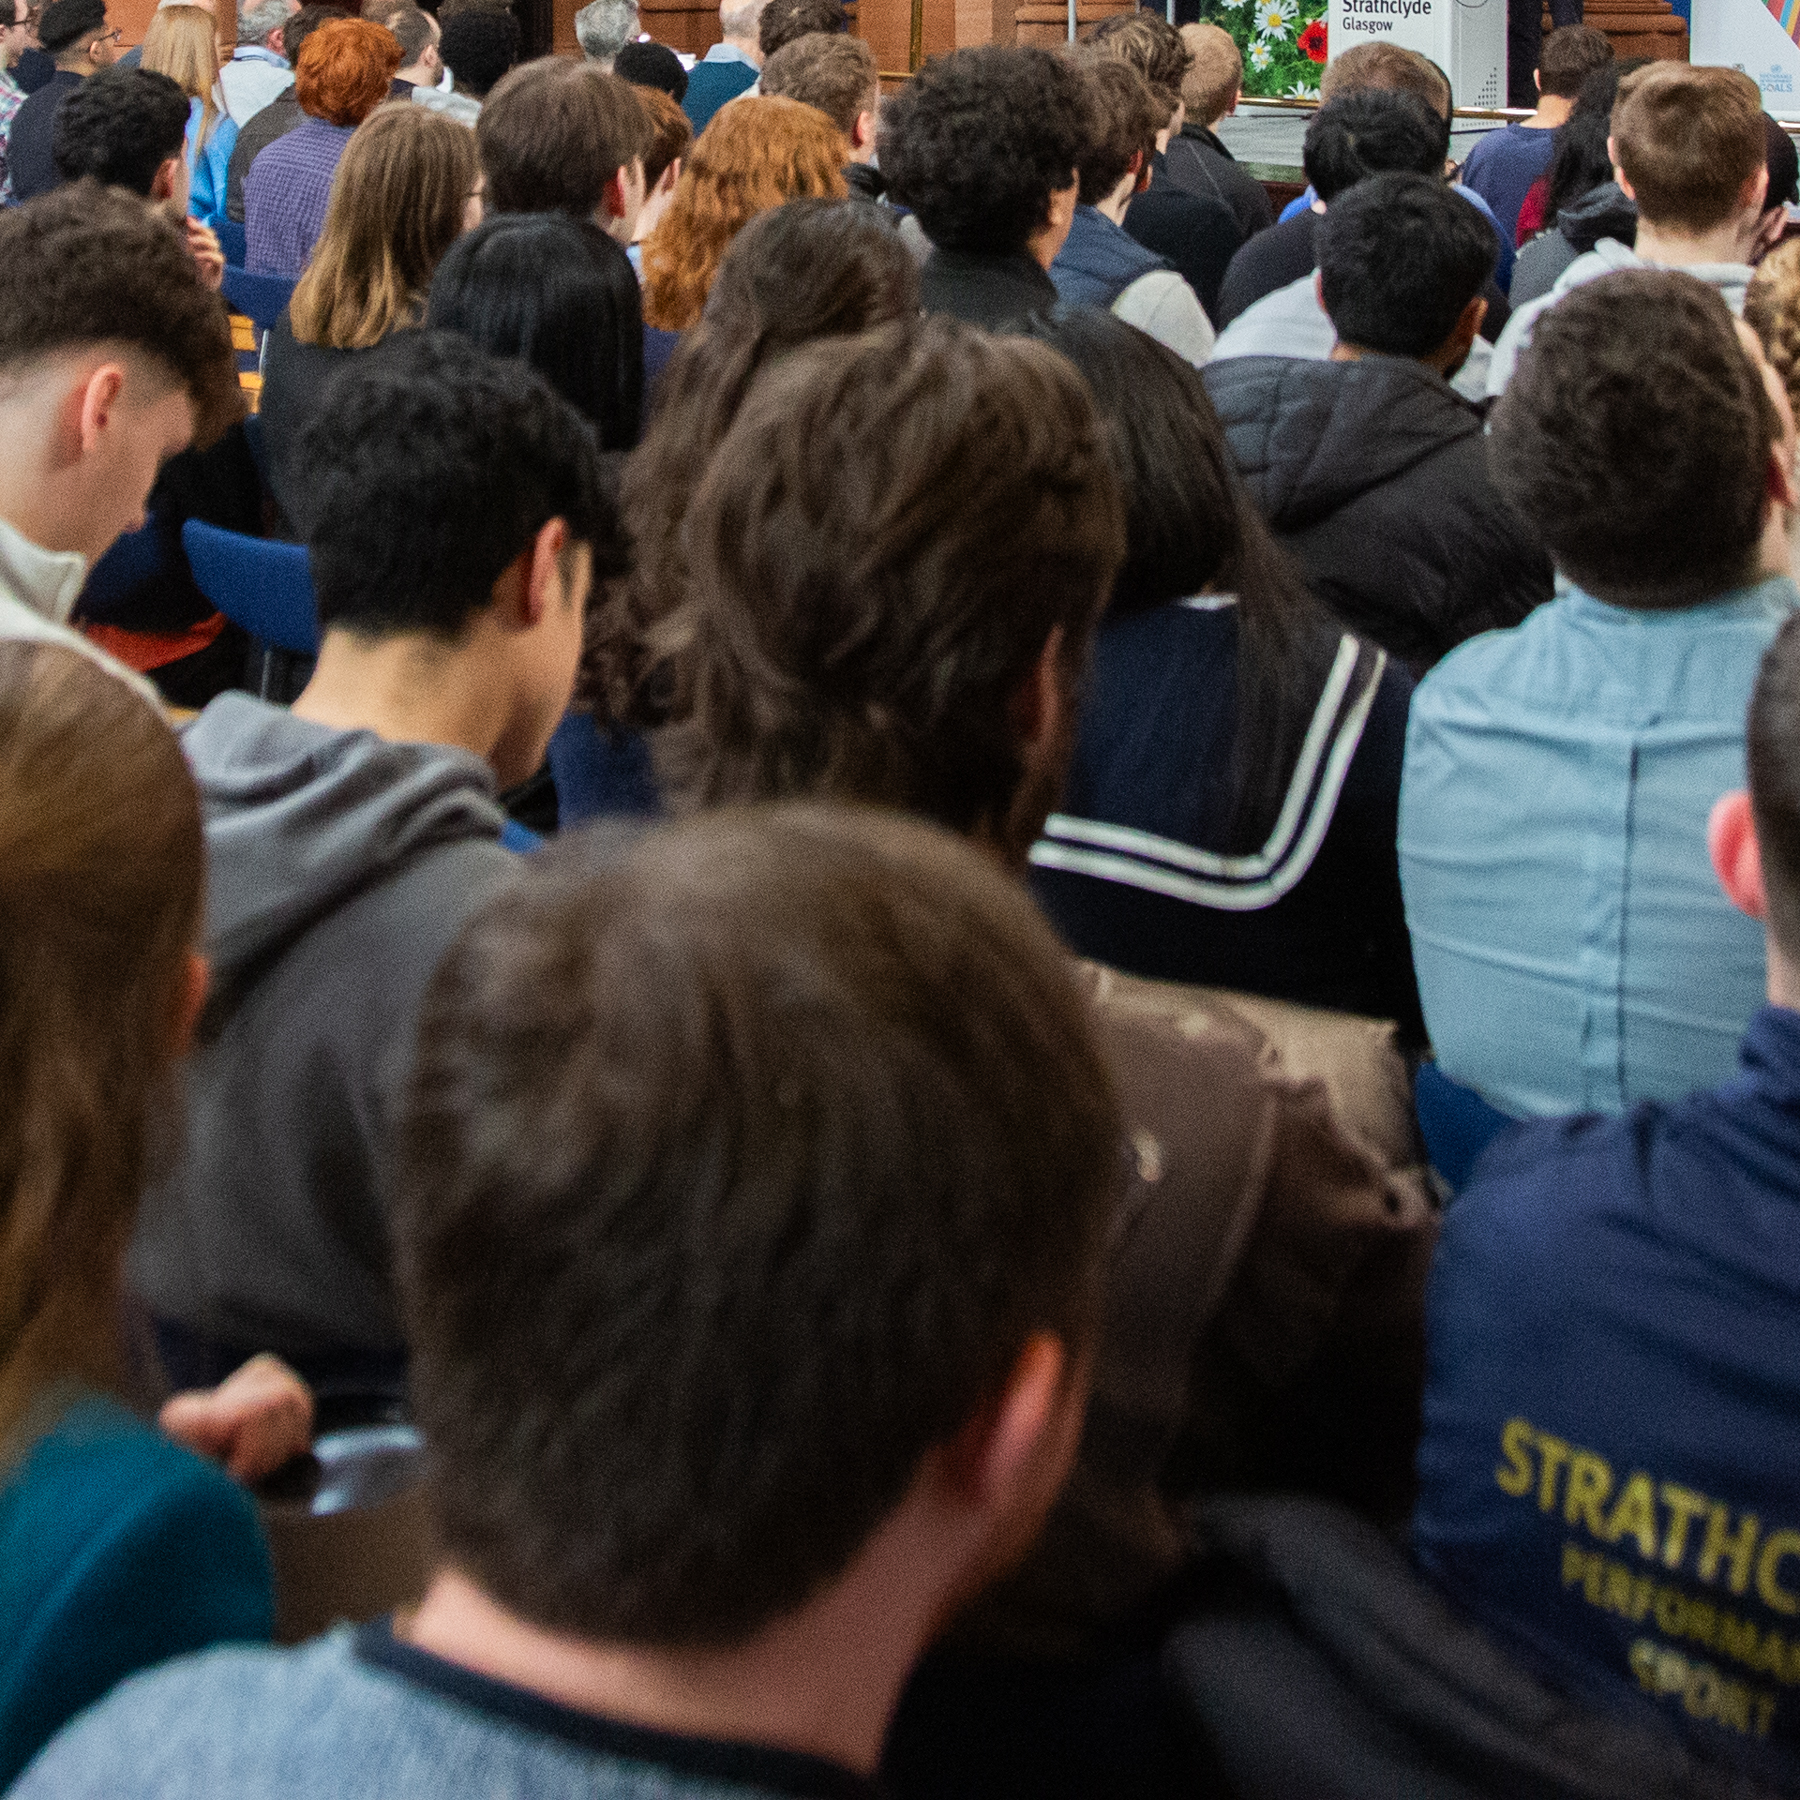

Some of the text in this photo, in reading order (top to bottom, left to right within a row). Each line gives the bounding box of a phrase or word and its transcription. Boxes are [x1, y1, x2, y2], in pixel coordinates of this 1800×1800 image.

[1342, 17, 1393, 34] Glasgow
[1759, 83, 1793, 92] GOALS
[1628, 1636, 1779, 1740] SPORT
